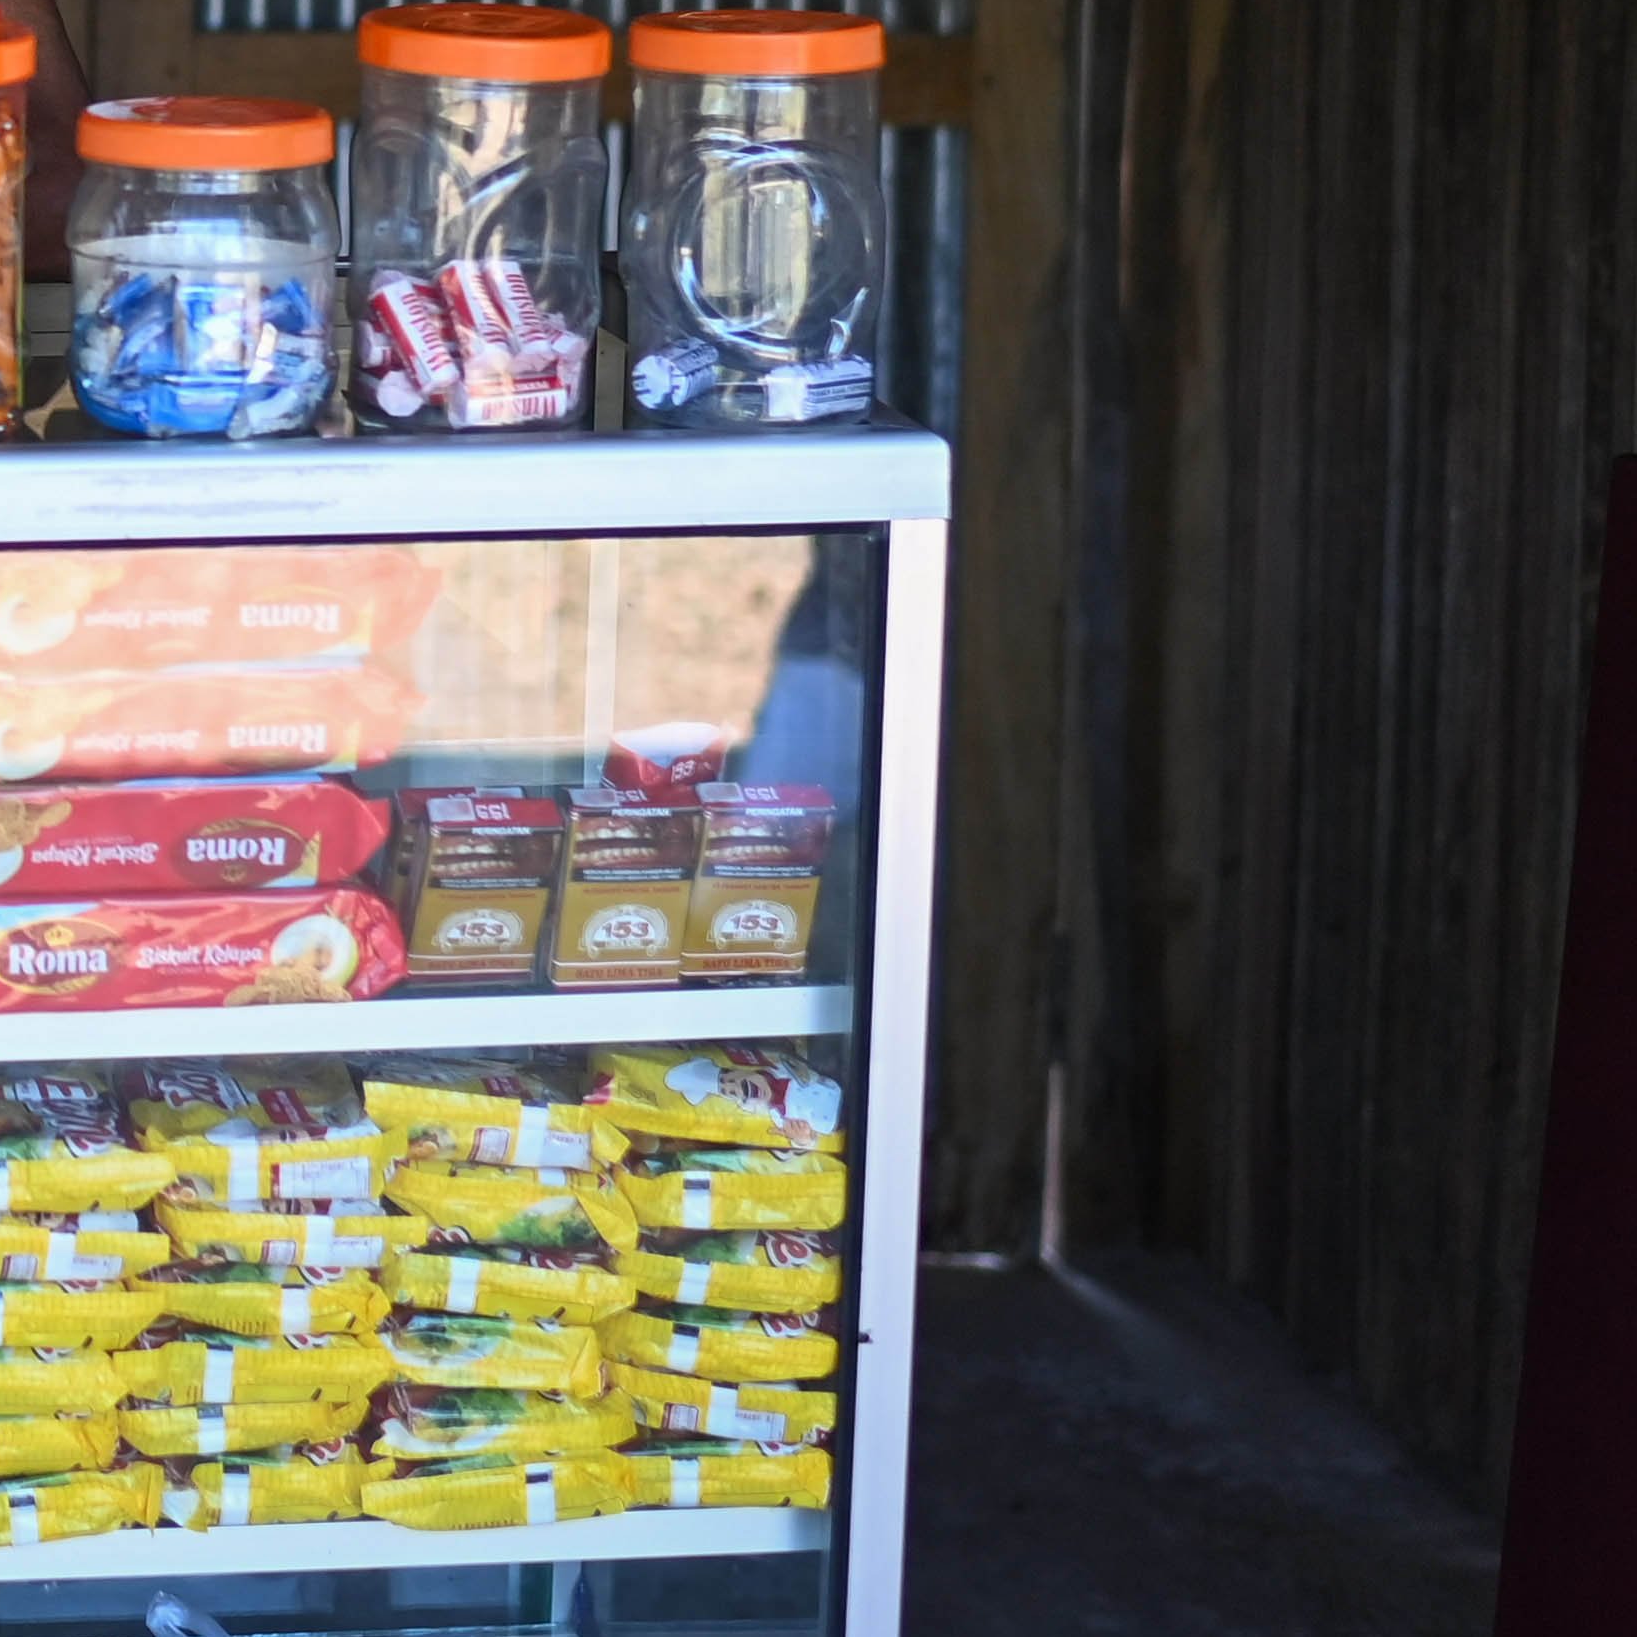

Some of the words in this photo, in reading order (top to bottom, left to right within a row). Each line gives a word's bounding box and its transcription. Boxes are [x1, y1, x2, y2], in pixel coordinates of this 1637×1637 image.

[239, 604, 341, 633] Roma
[226, 724, 327, 753] Roma
[743, 785, 780, 801] 153
[30, 841, 90, 866] Kelapa
[91, 841, 159, 864] Biskuit
[185, 836, 287, 866] Roma
[455, 922, 505, 938] 153
[601, 920, 650, 939] 153
[729, 914, 779, 932] 153
[8, 944, 110, 974] Roma
[135, 945, 202, 969] Biskuit
[204, 943, 264, 969] Kelapa
[606, 967, 635, 978] LIMA
